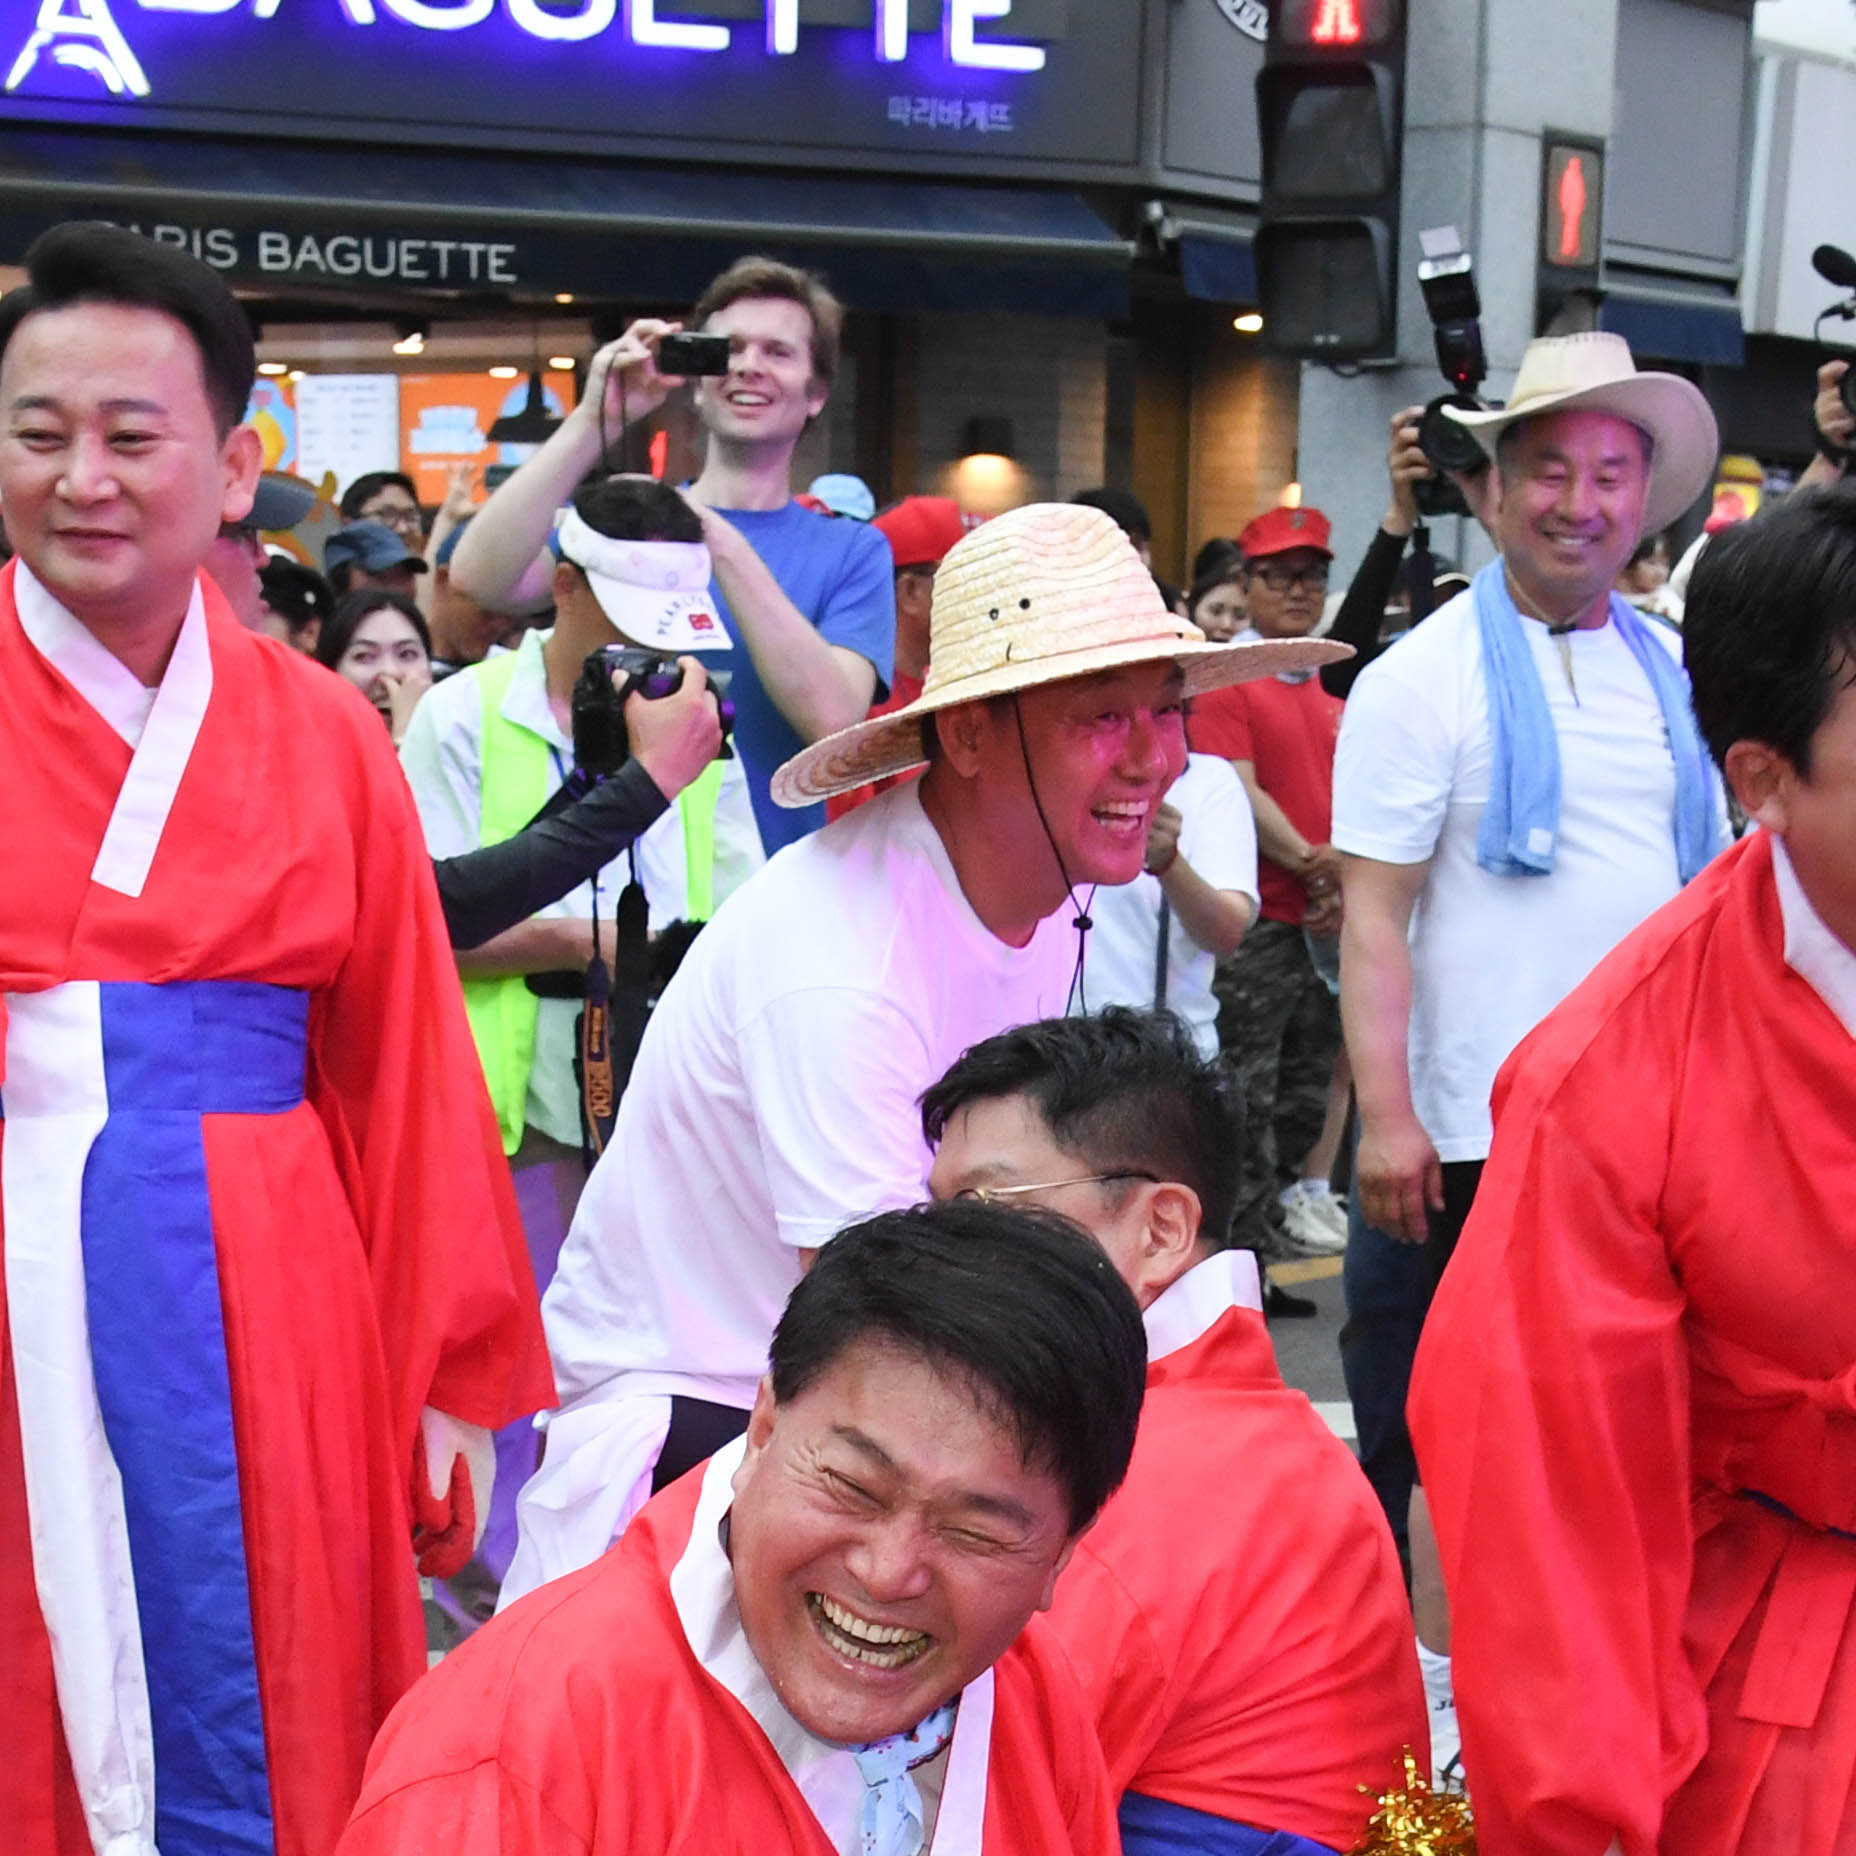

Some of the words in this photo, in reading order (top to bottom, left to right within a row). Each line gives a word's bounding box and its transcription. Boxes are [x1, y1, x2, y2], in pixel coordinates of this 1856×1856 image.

[888, 96, 1014, 132] 파리바게뜨
[102, 221, 239, 269] RIS
[258, 231, 518, 283] BAGUETTE
